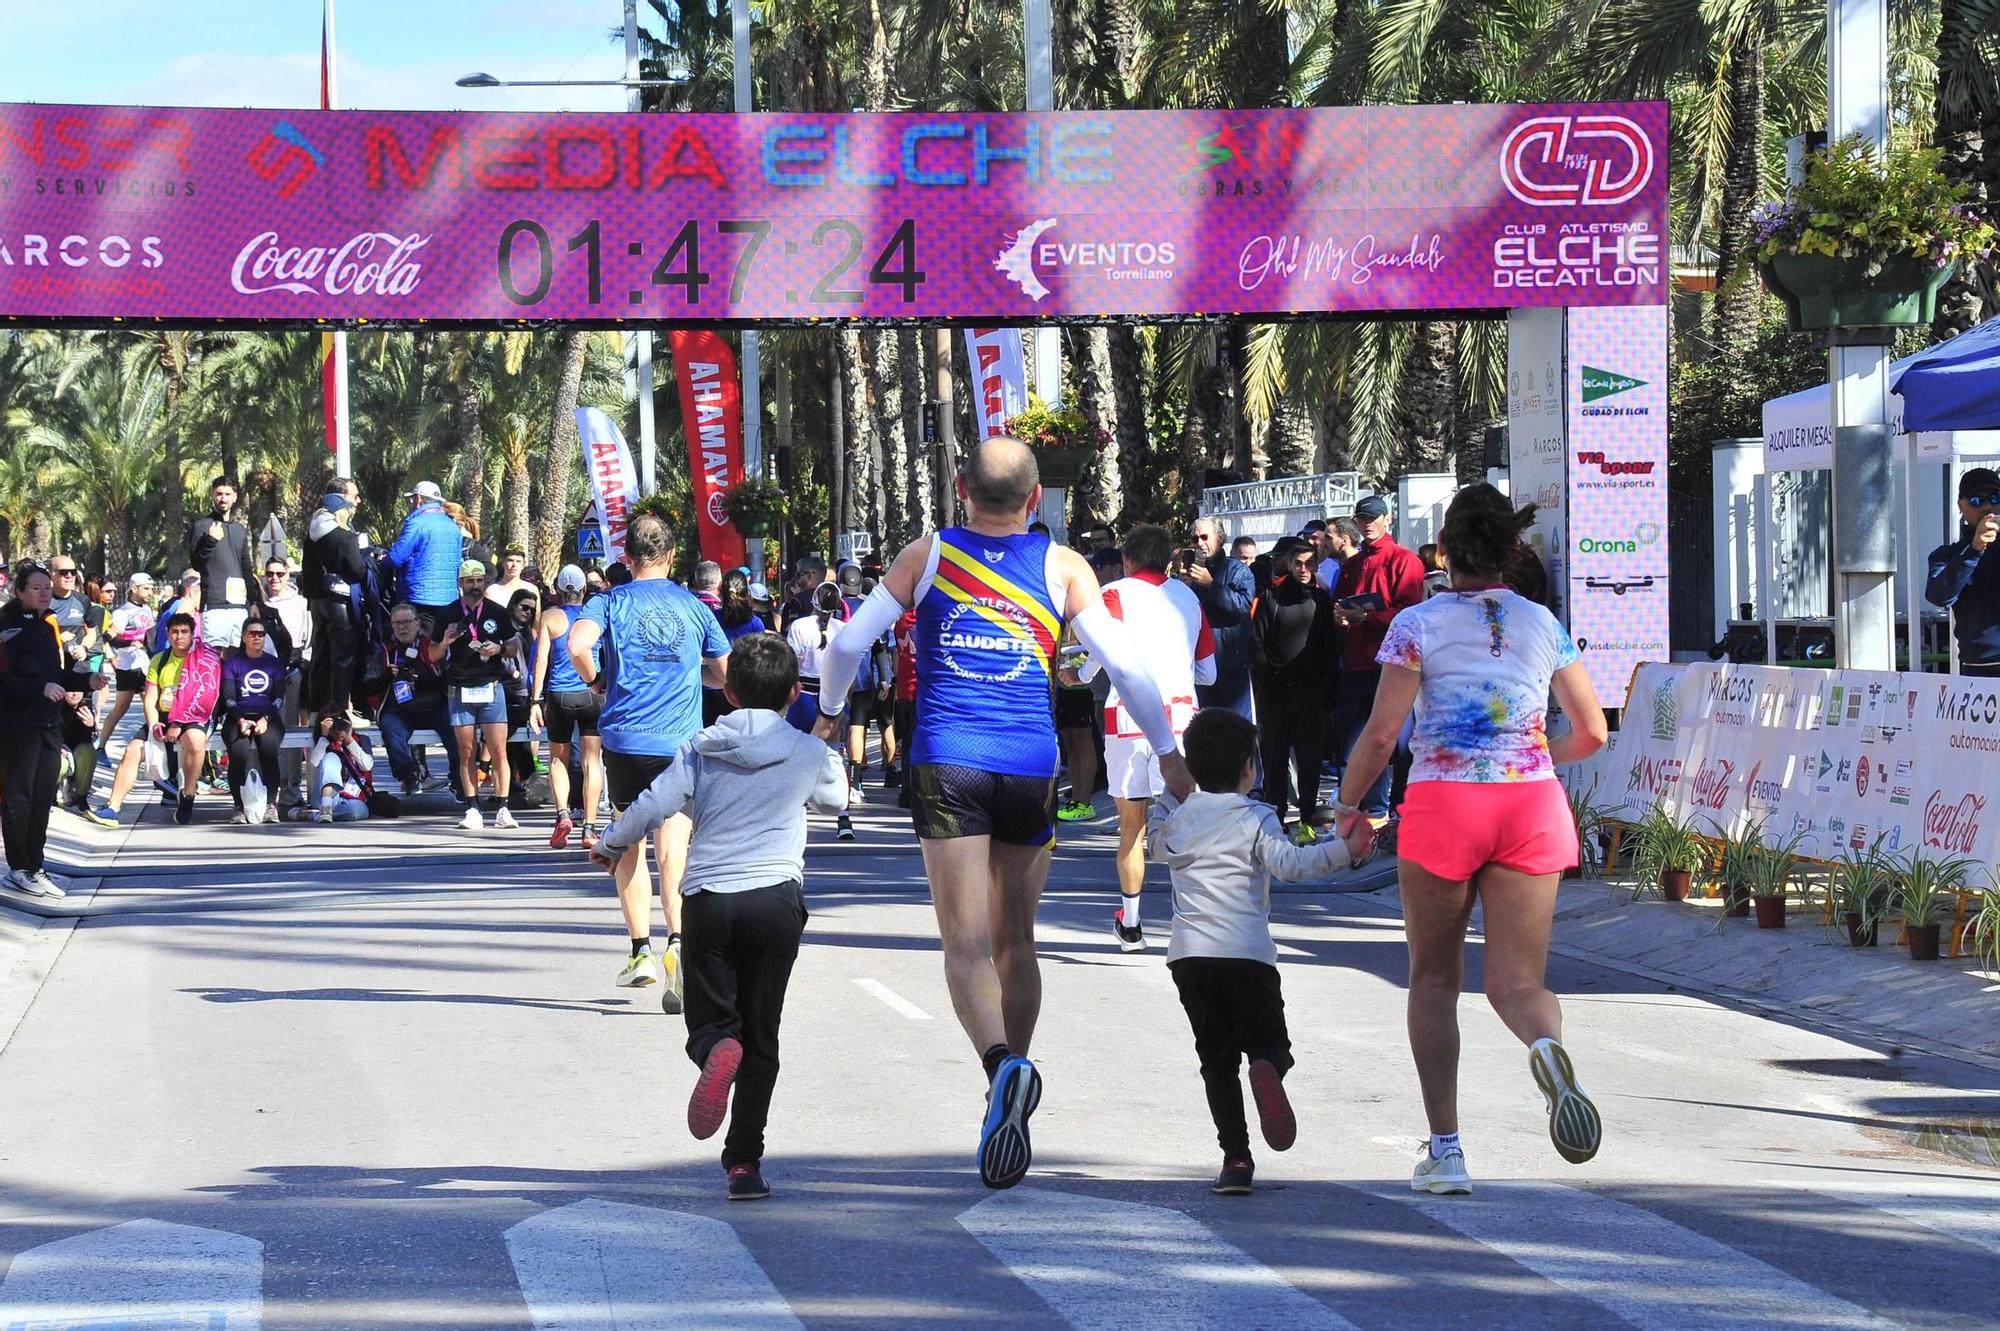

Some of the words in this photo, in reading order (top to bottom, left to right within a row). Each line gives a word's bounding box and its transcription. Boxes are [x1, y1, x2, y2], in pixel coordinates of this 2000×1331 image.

[364, 124, 728, 191] MEDIA
[761, 123, 1114, 187] ELCHE
[36, 178, 195, 197] SERVICIOS
[1179, 180, 1263, 197] OBRAS
[1283, 180, 1294, 196] Y
[1504, 224, 1546, 235] CLUB
[1559, 222, 1649, 235] ATLETISMO
[231, 232, 433, 295] Coca-Cola
[498, 218, 926, 305] 01:47:24
[1039, 242, 1175, 266] EVENTOS
[1304, 237, 1350, 281] My
[1351, 234, 1446, 285] Sandals
[1494, 235, 1659, 267] ELCHE
[1105, 267, 1173, 281] Torrellano
[1494, 267, 1659, 288] DECATLON
[688, 361, 728, 487] AHAMAY
[1582, 408, 1612, 416] CIUDAD
[1614, 408, 1624, 416] DE
[1626, 407, 1649, 415] ELCHE
[1768, 427, 1806, 453] ALQUILER
[591, 443, 628, 547] AHAMAY
[1579, 538, 1636, 553] Orona
[941, 603, 968, 631] CLUB
[971, 597, 1035, 638] ATLETISMO
[940, 632, 1035, 650] CAUDETE
[1589, 641, 1663, 650] visitelche.com
[940, 649, 983, 682] ANTONIO
[1936, 684, 2000, 724] MARCO
[1752, 780, 1782, 802] EVENTOS
[1923, 789, 1988, 853] Coca-Cola
[1440, 1135, 1458, 1143] PUM
